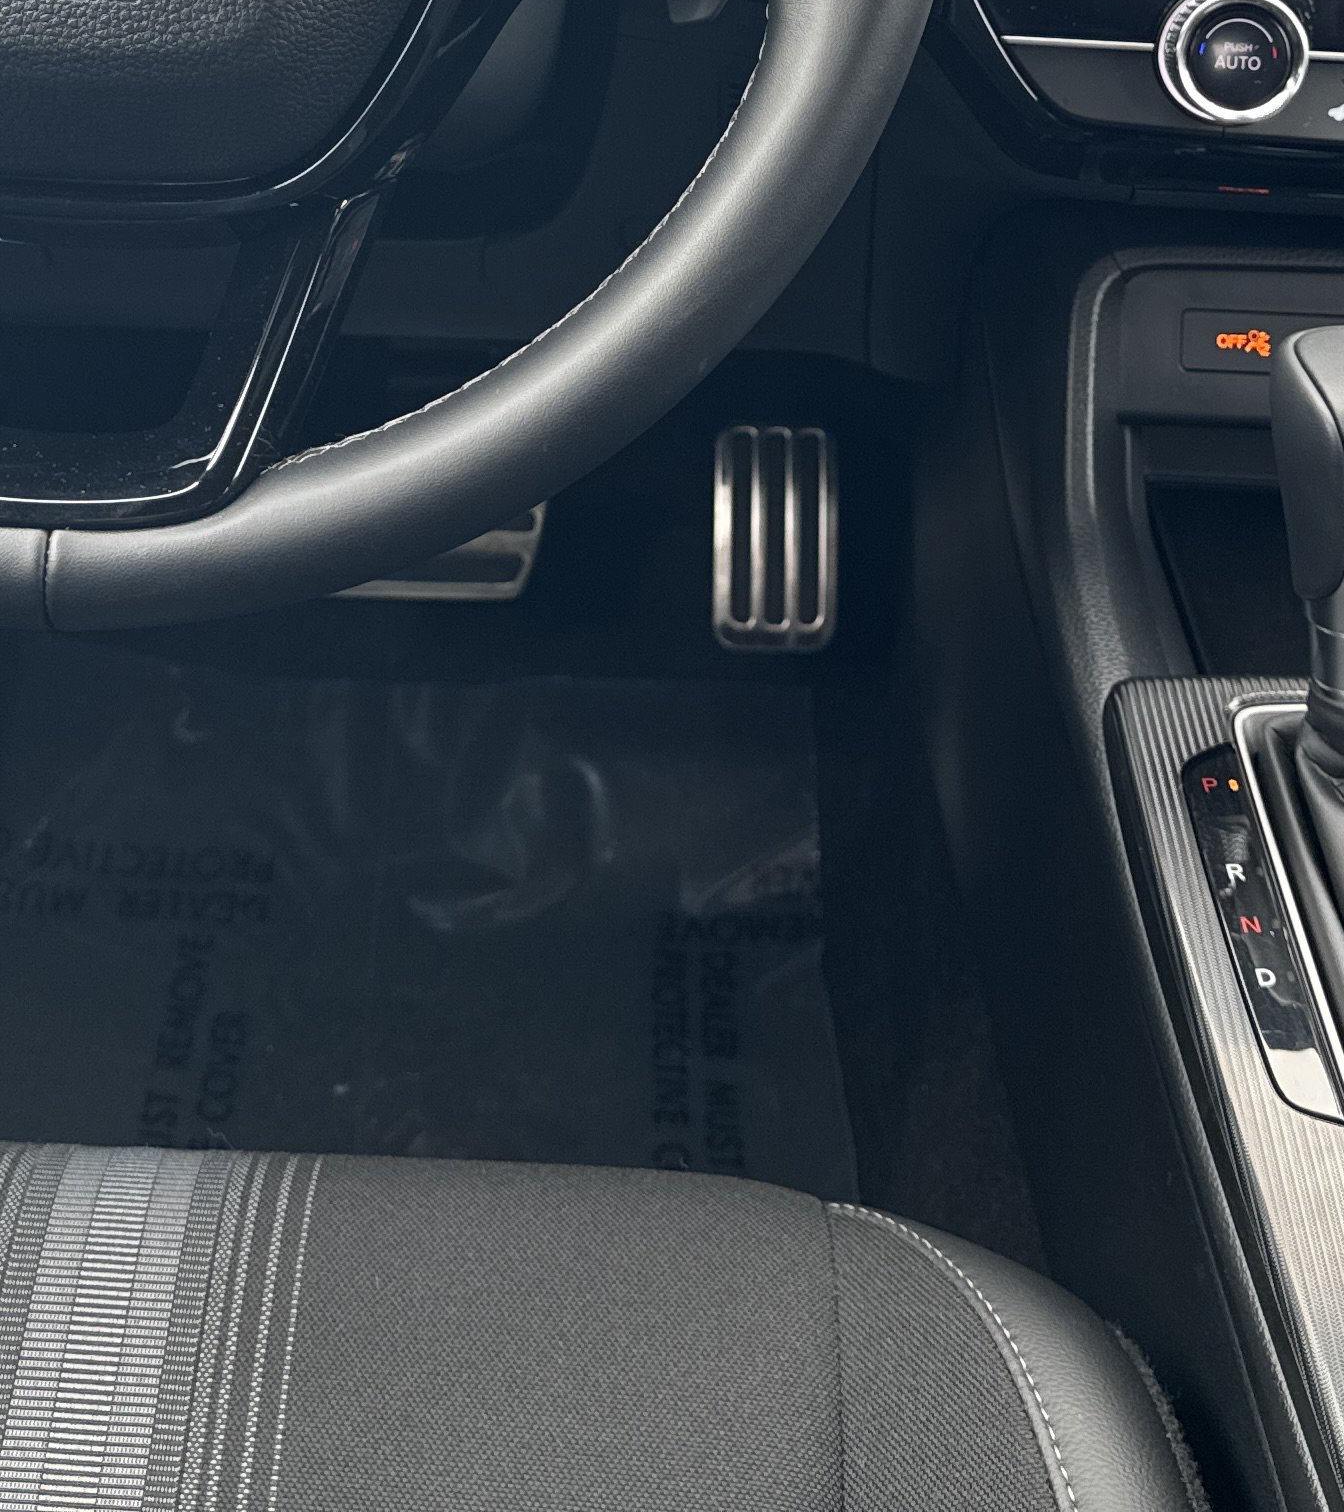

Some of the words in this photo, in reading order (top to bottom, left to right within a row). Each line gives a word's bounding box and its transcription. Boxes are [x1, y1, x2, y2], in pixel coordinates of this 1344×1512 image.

[1224, 41, 1253, 53] PUSH
[1214, 55, 1262, 71] AUTO
[1216, 333, 1248, 350] OFF
[1201, 776, 1218, 793] P
[1224, 862, 1246, 881] R
[1239, 915, 1262, 933] N
[1255, 967, 1276, 987] D
